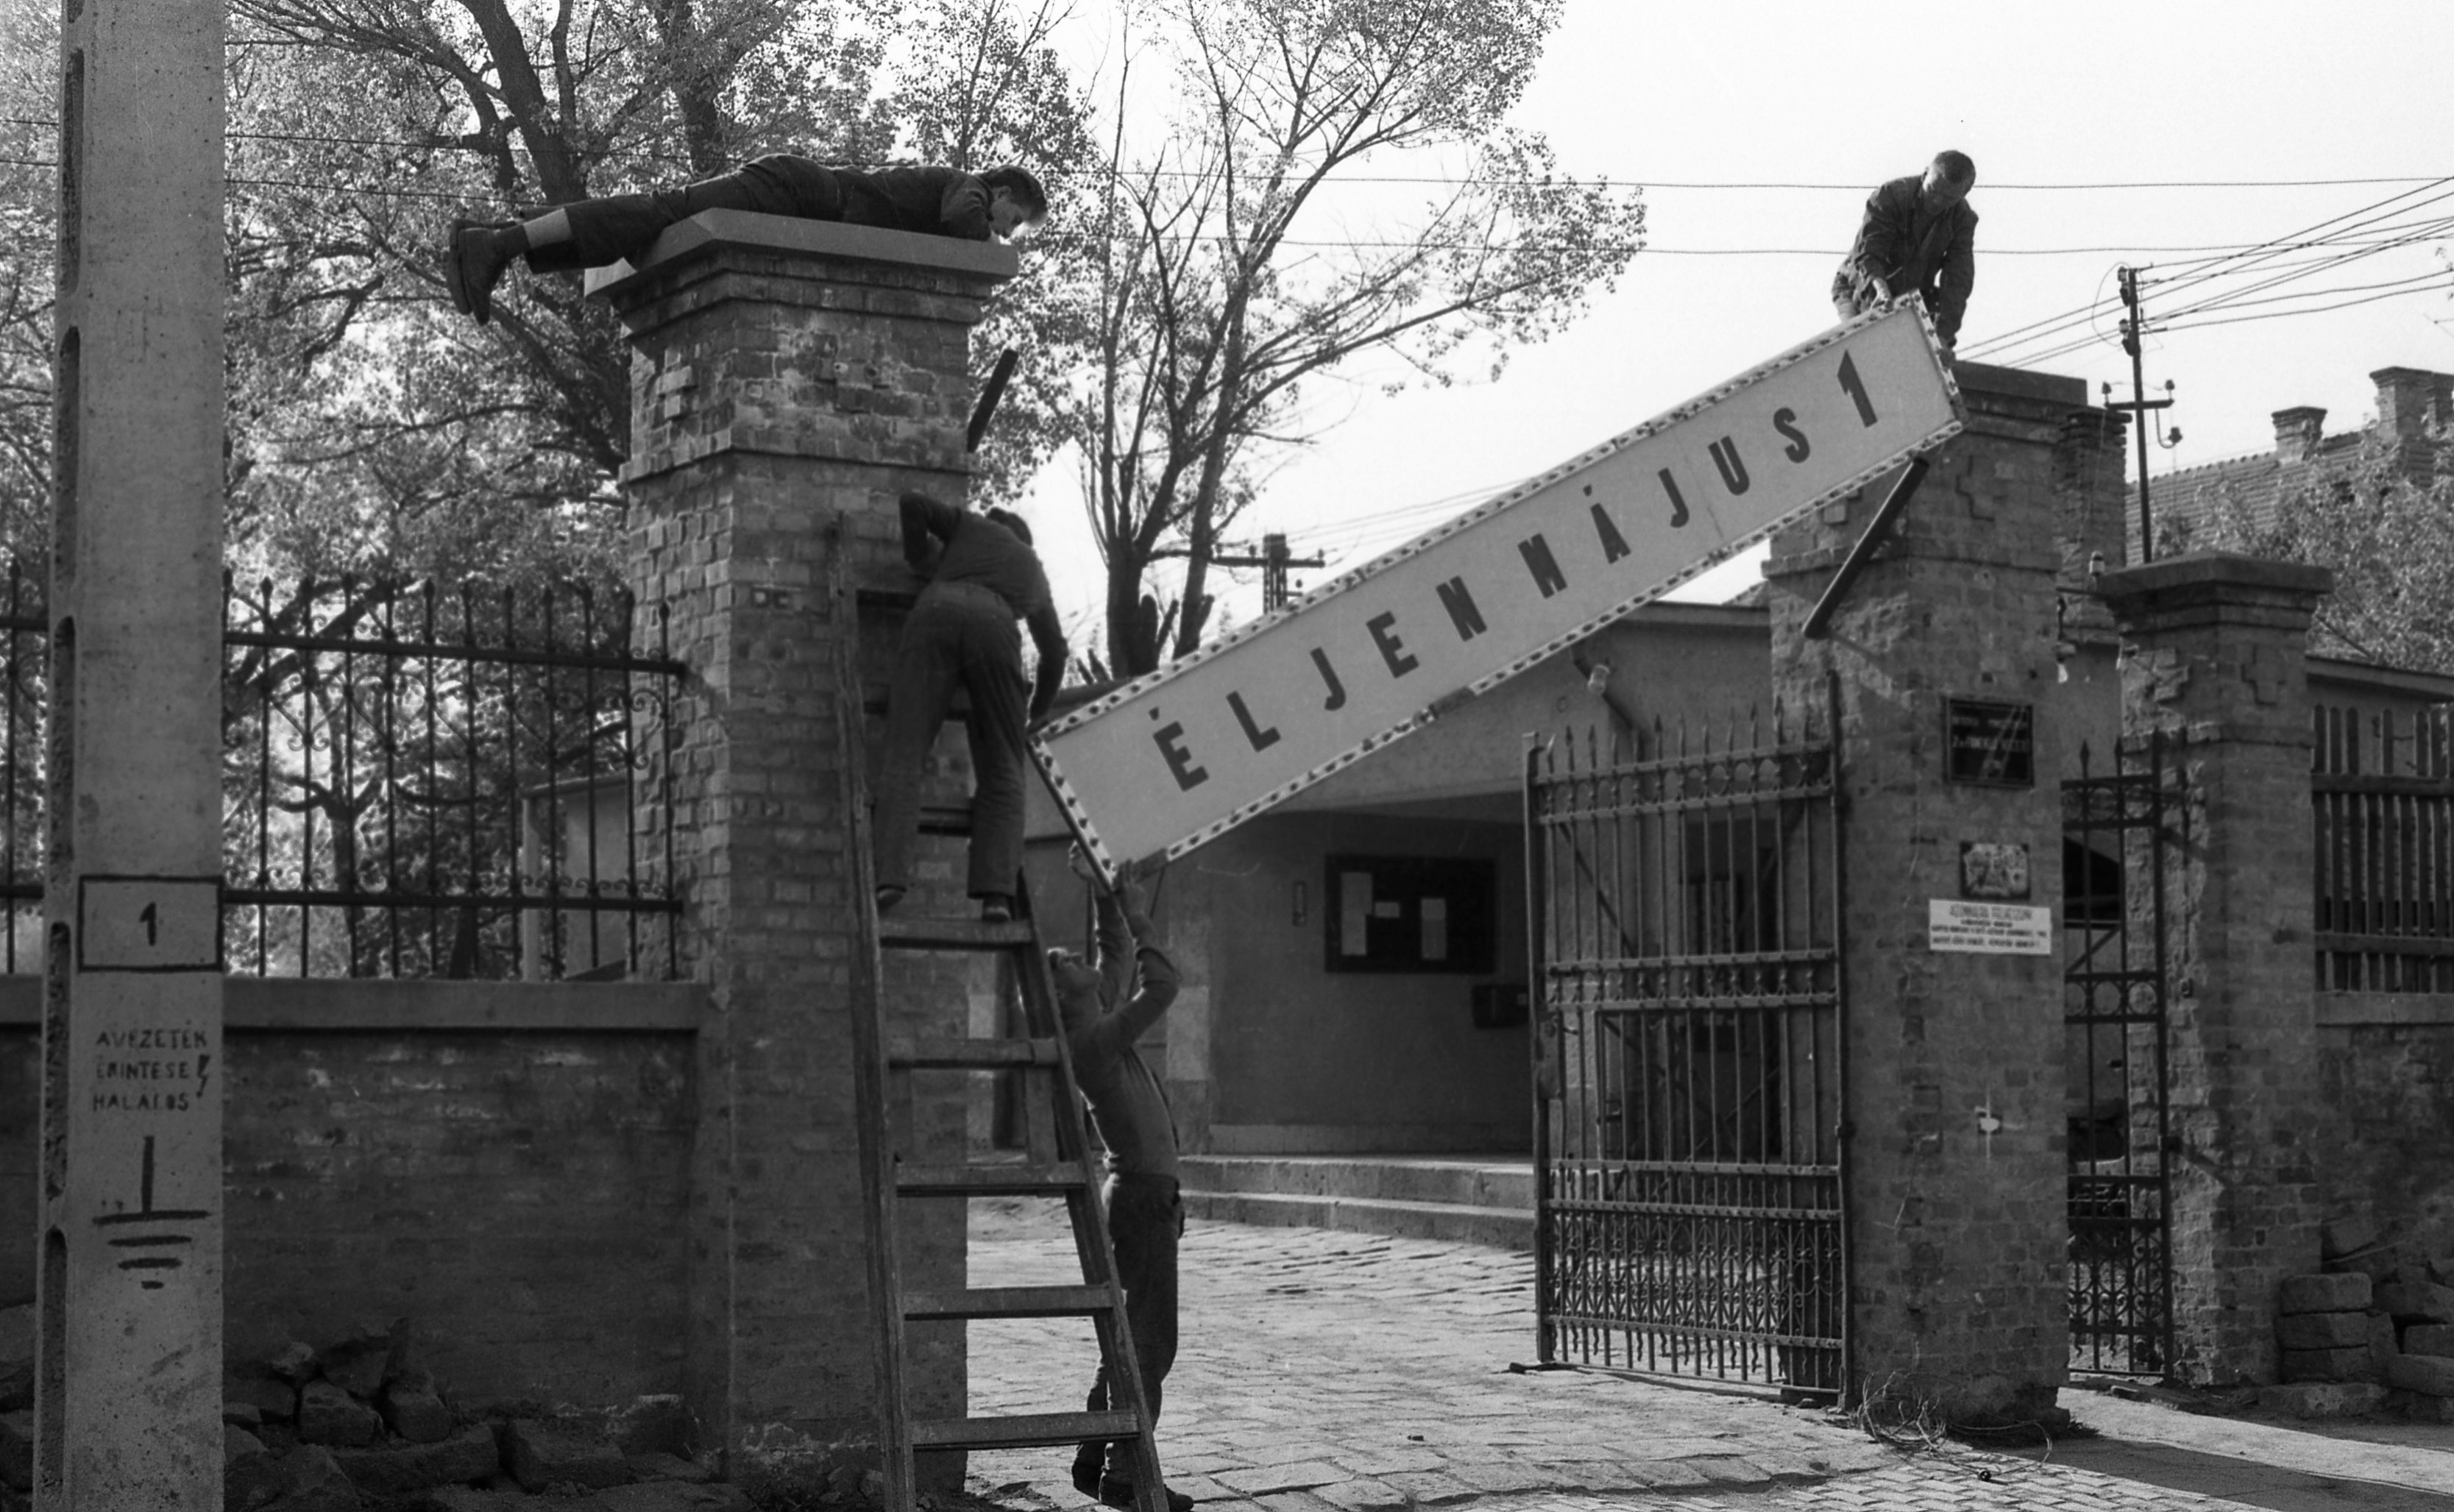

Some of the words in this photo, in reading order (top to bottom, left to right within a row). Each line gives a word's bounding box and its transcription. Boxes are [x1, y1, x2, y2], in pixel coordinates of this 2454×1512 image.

[1149, 576, 1487, 792] ÉLJEN
[1518, 408, 1810, 598] MÁJUS
[1837, 349, 1877, 427] 1
[139, 902, 157, 946] 1
